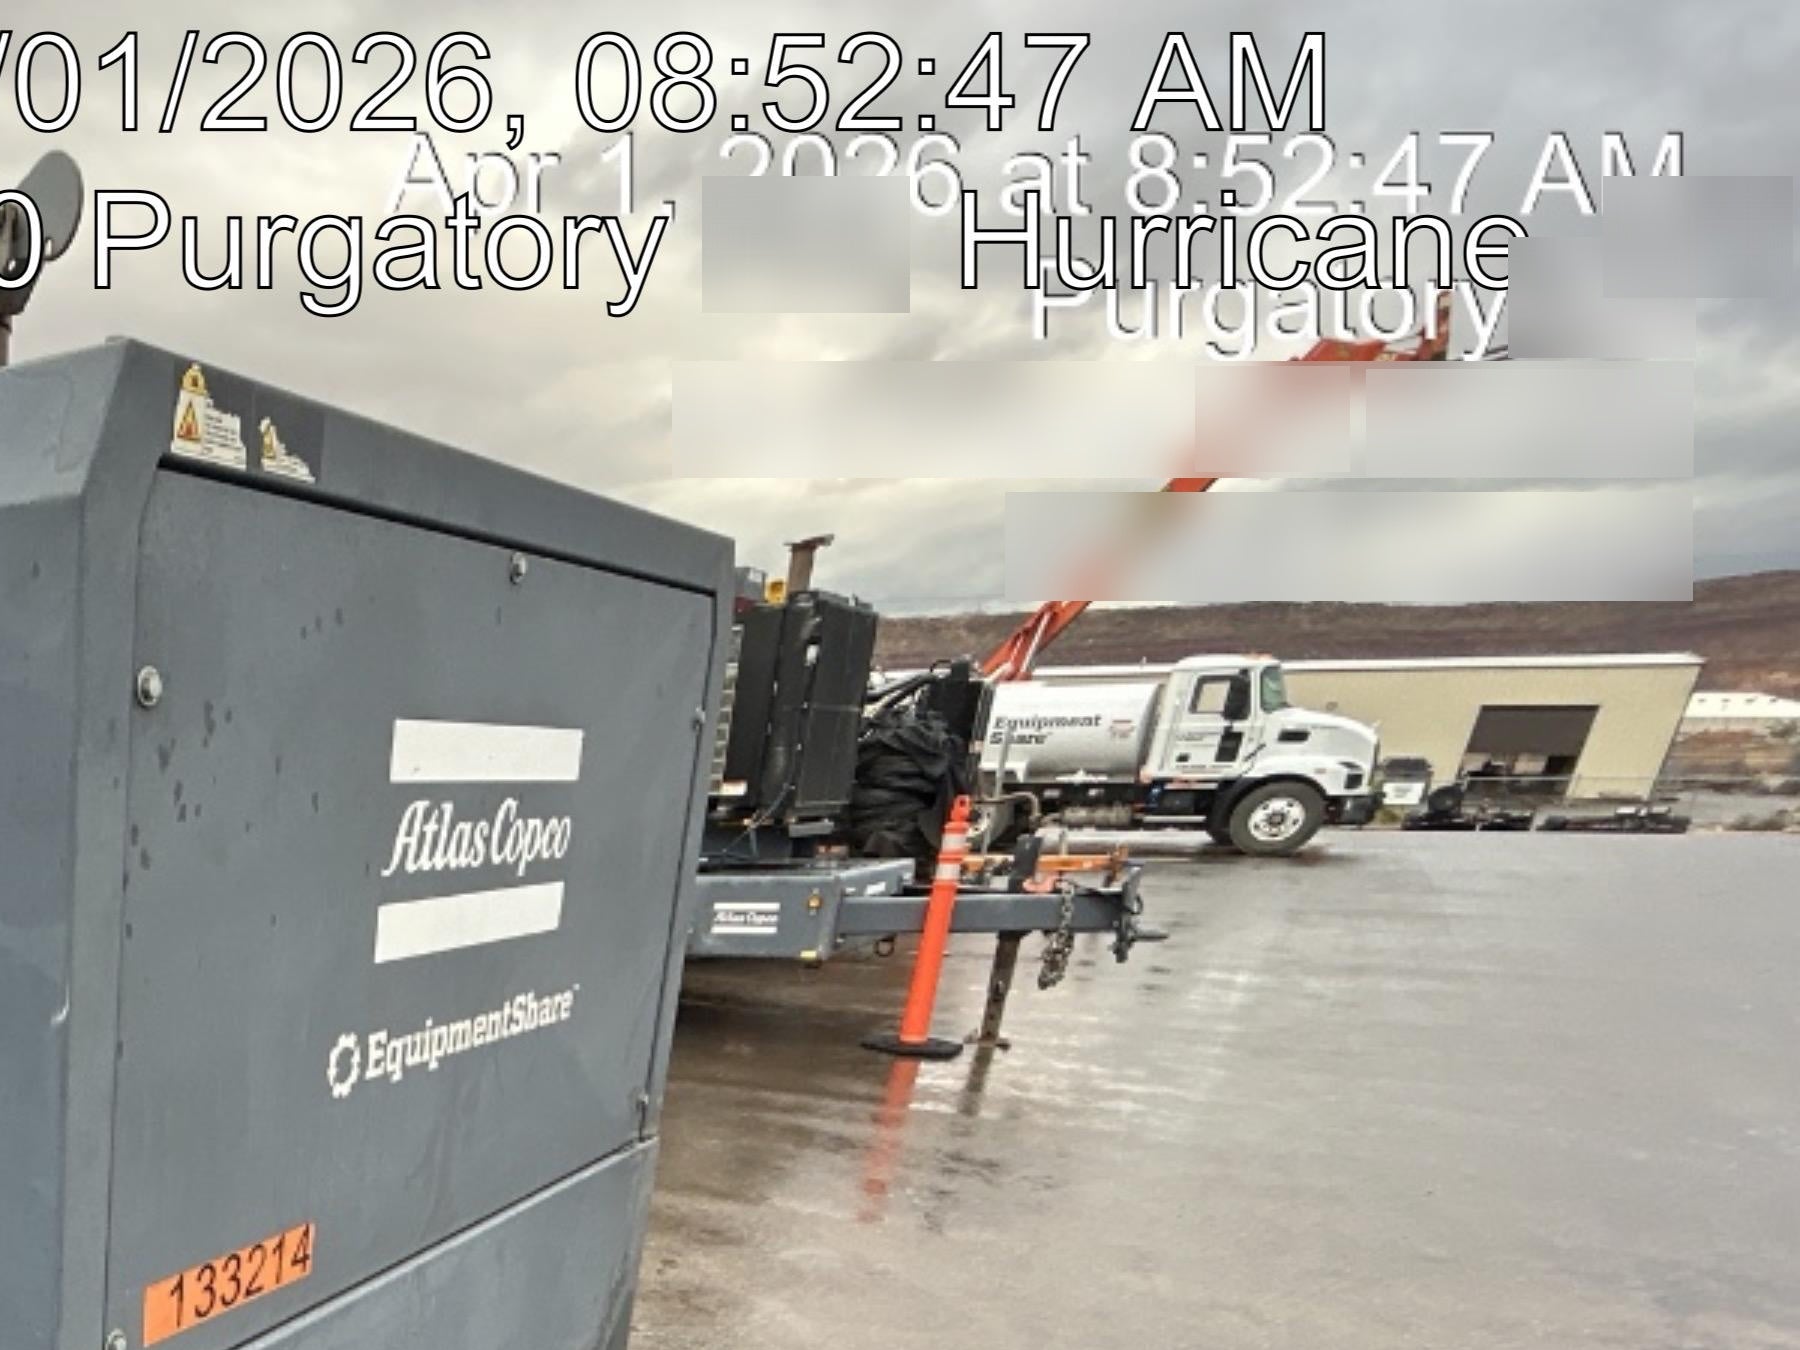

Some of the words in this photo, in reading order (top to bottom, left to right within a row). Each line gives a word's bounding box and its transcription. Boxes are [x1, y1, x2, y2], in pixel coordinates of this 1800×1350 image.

[989, 731, 1046, 745] Sare
[994, 714, 1102, 731] Equipment
[380, 799, 490, 877] Atlas
[490, 797, 573, 877] Copco
[364, 988, 575, 1085] EquipmentShare
[168, 1222, 311, 1329] 133214
